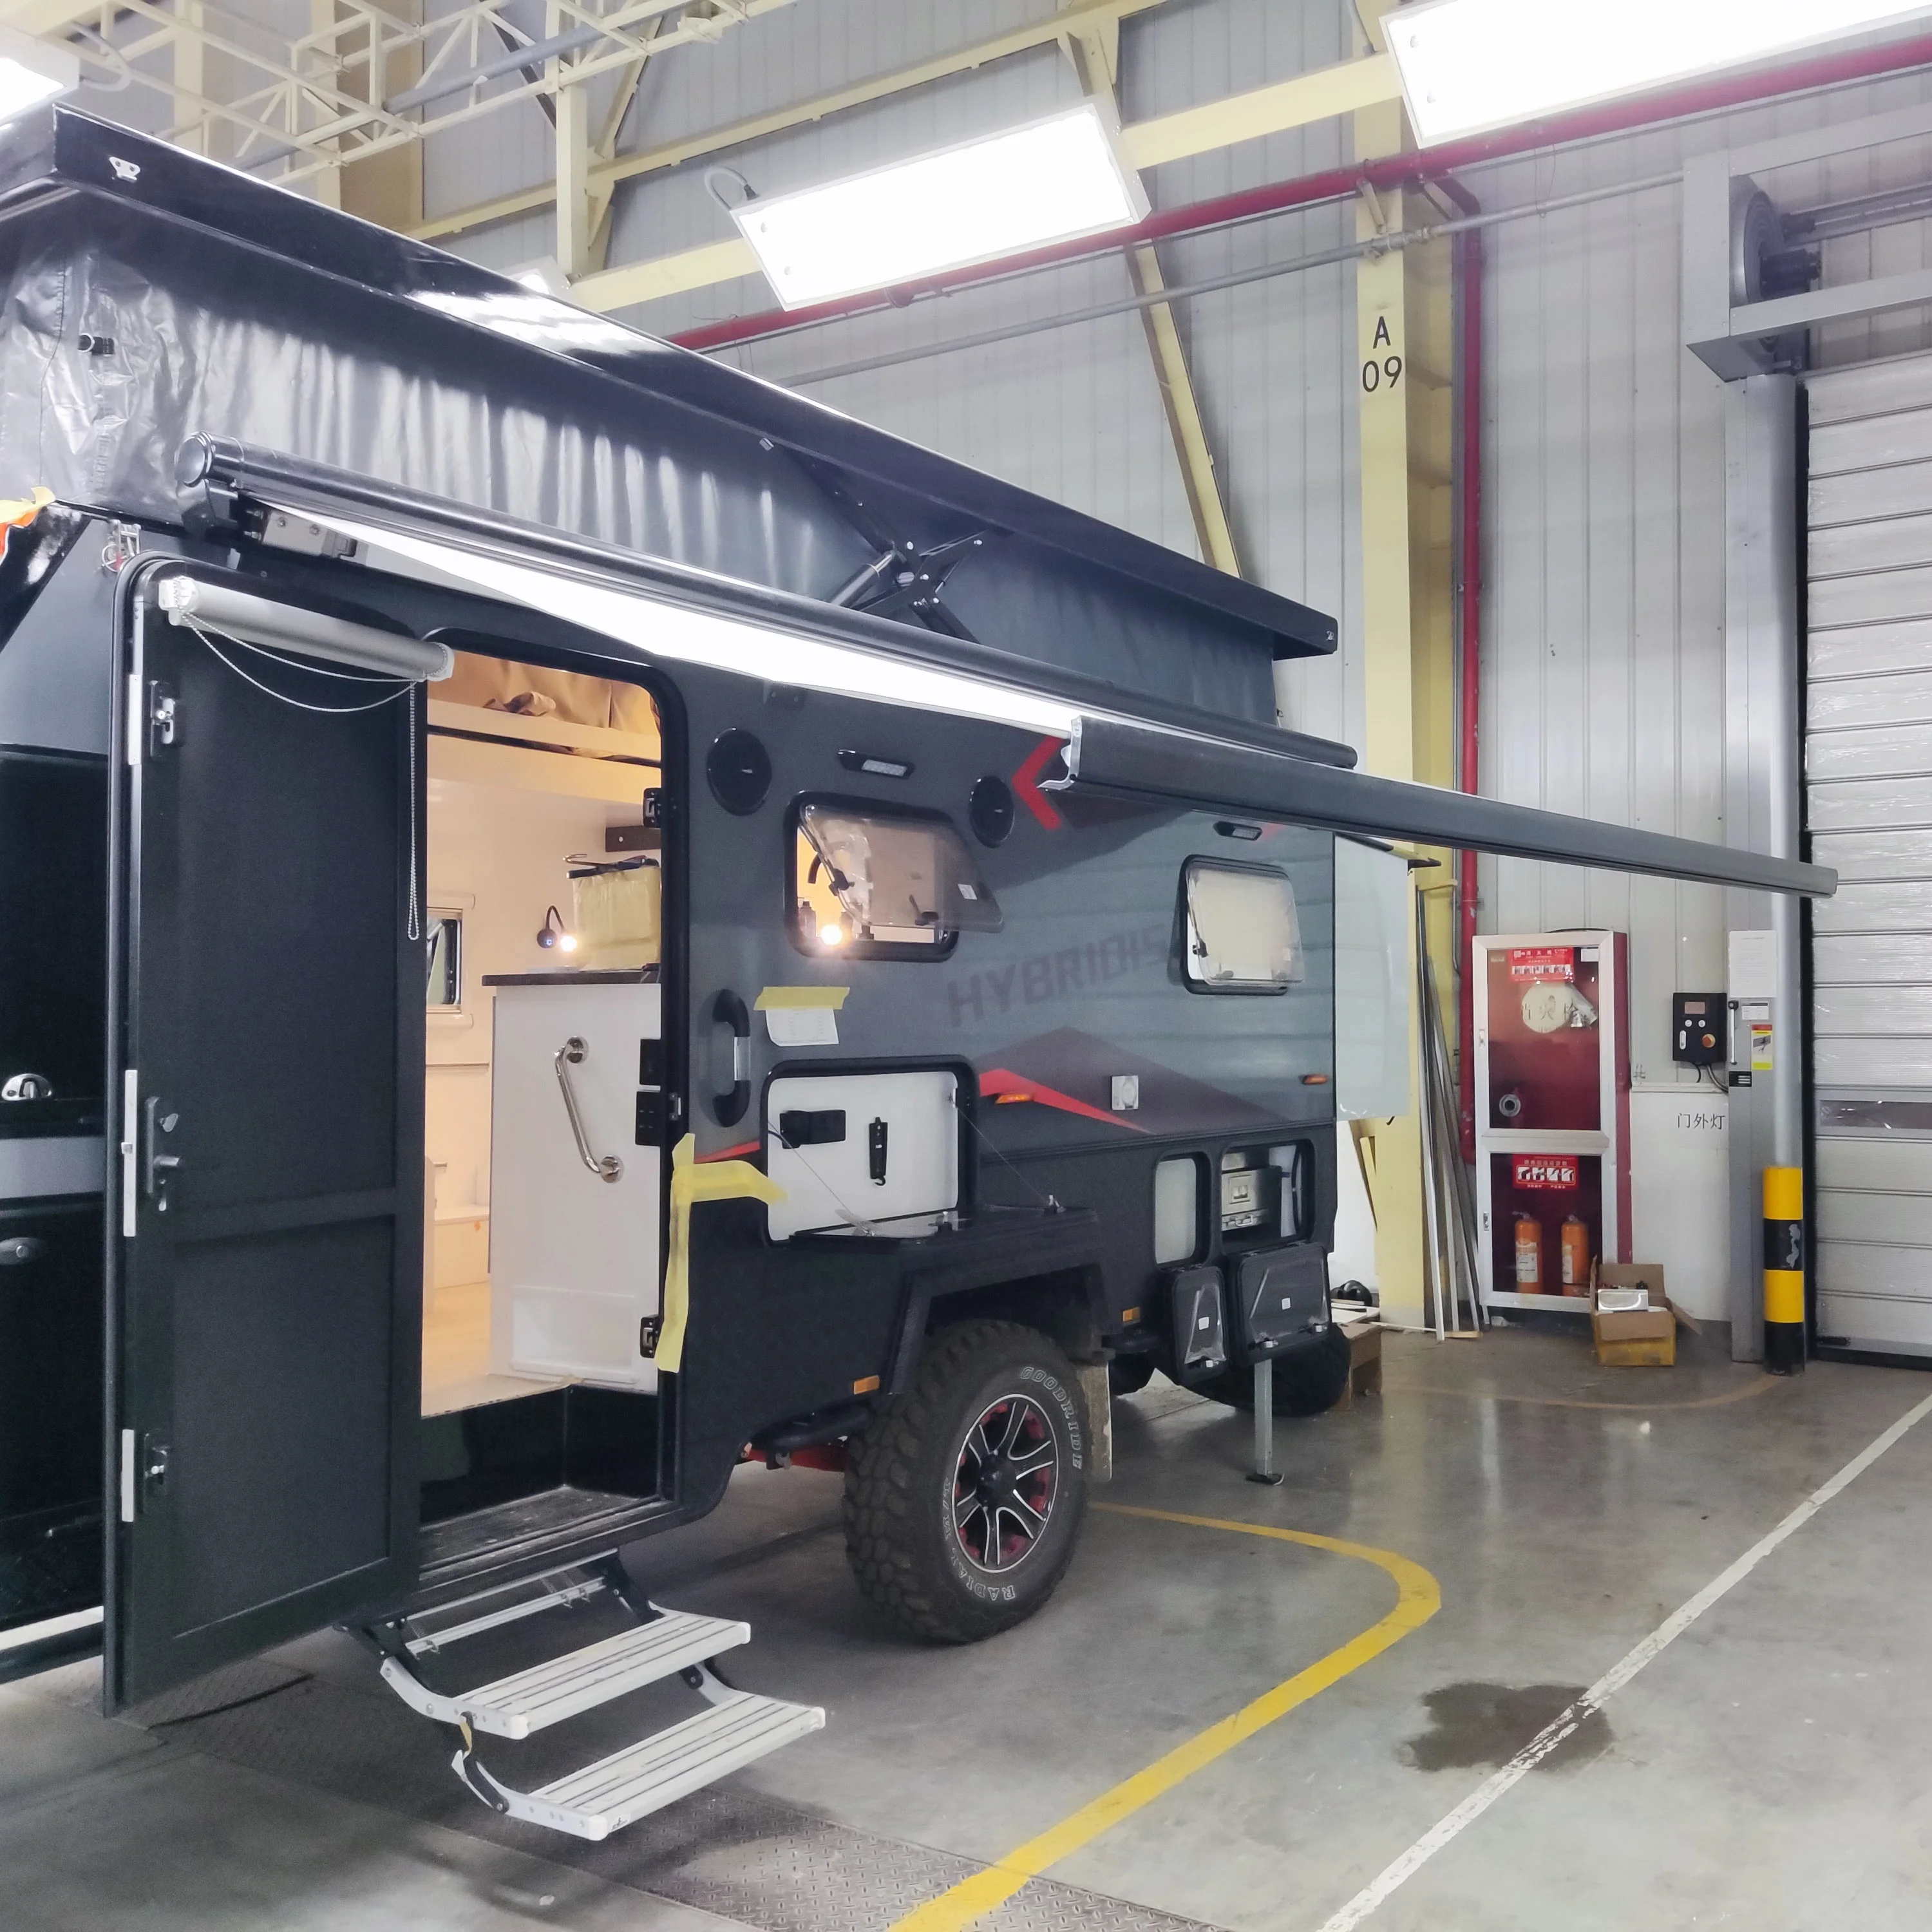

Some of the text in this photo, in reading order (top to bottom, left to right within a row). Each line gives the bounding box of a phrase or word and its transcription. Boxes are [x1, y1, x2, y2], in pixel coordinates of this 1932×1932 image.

[1373, 316, 1391, 349] A
[1363, 356, 1402, 392] 09
[1677, 1113, 1726, 1130] 门外灯
[1021, 1367, 1082, 1470] GOODRIDE
[951, 1548, 1016, 1601] RADIAL
